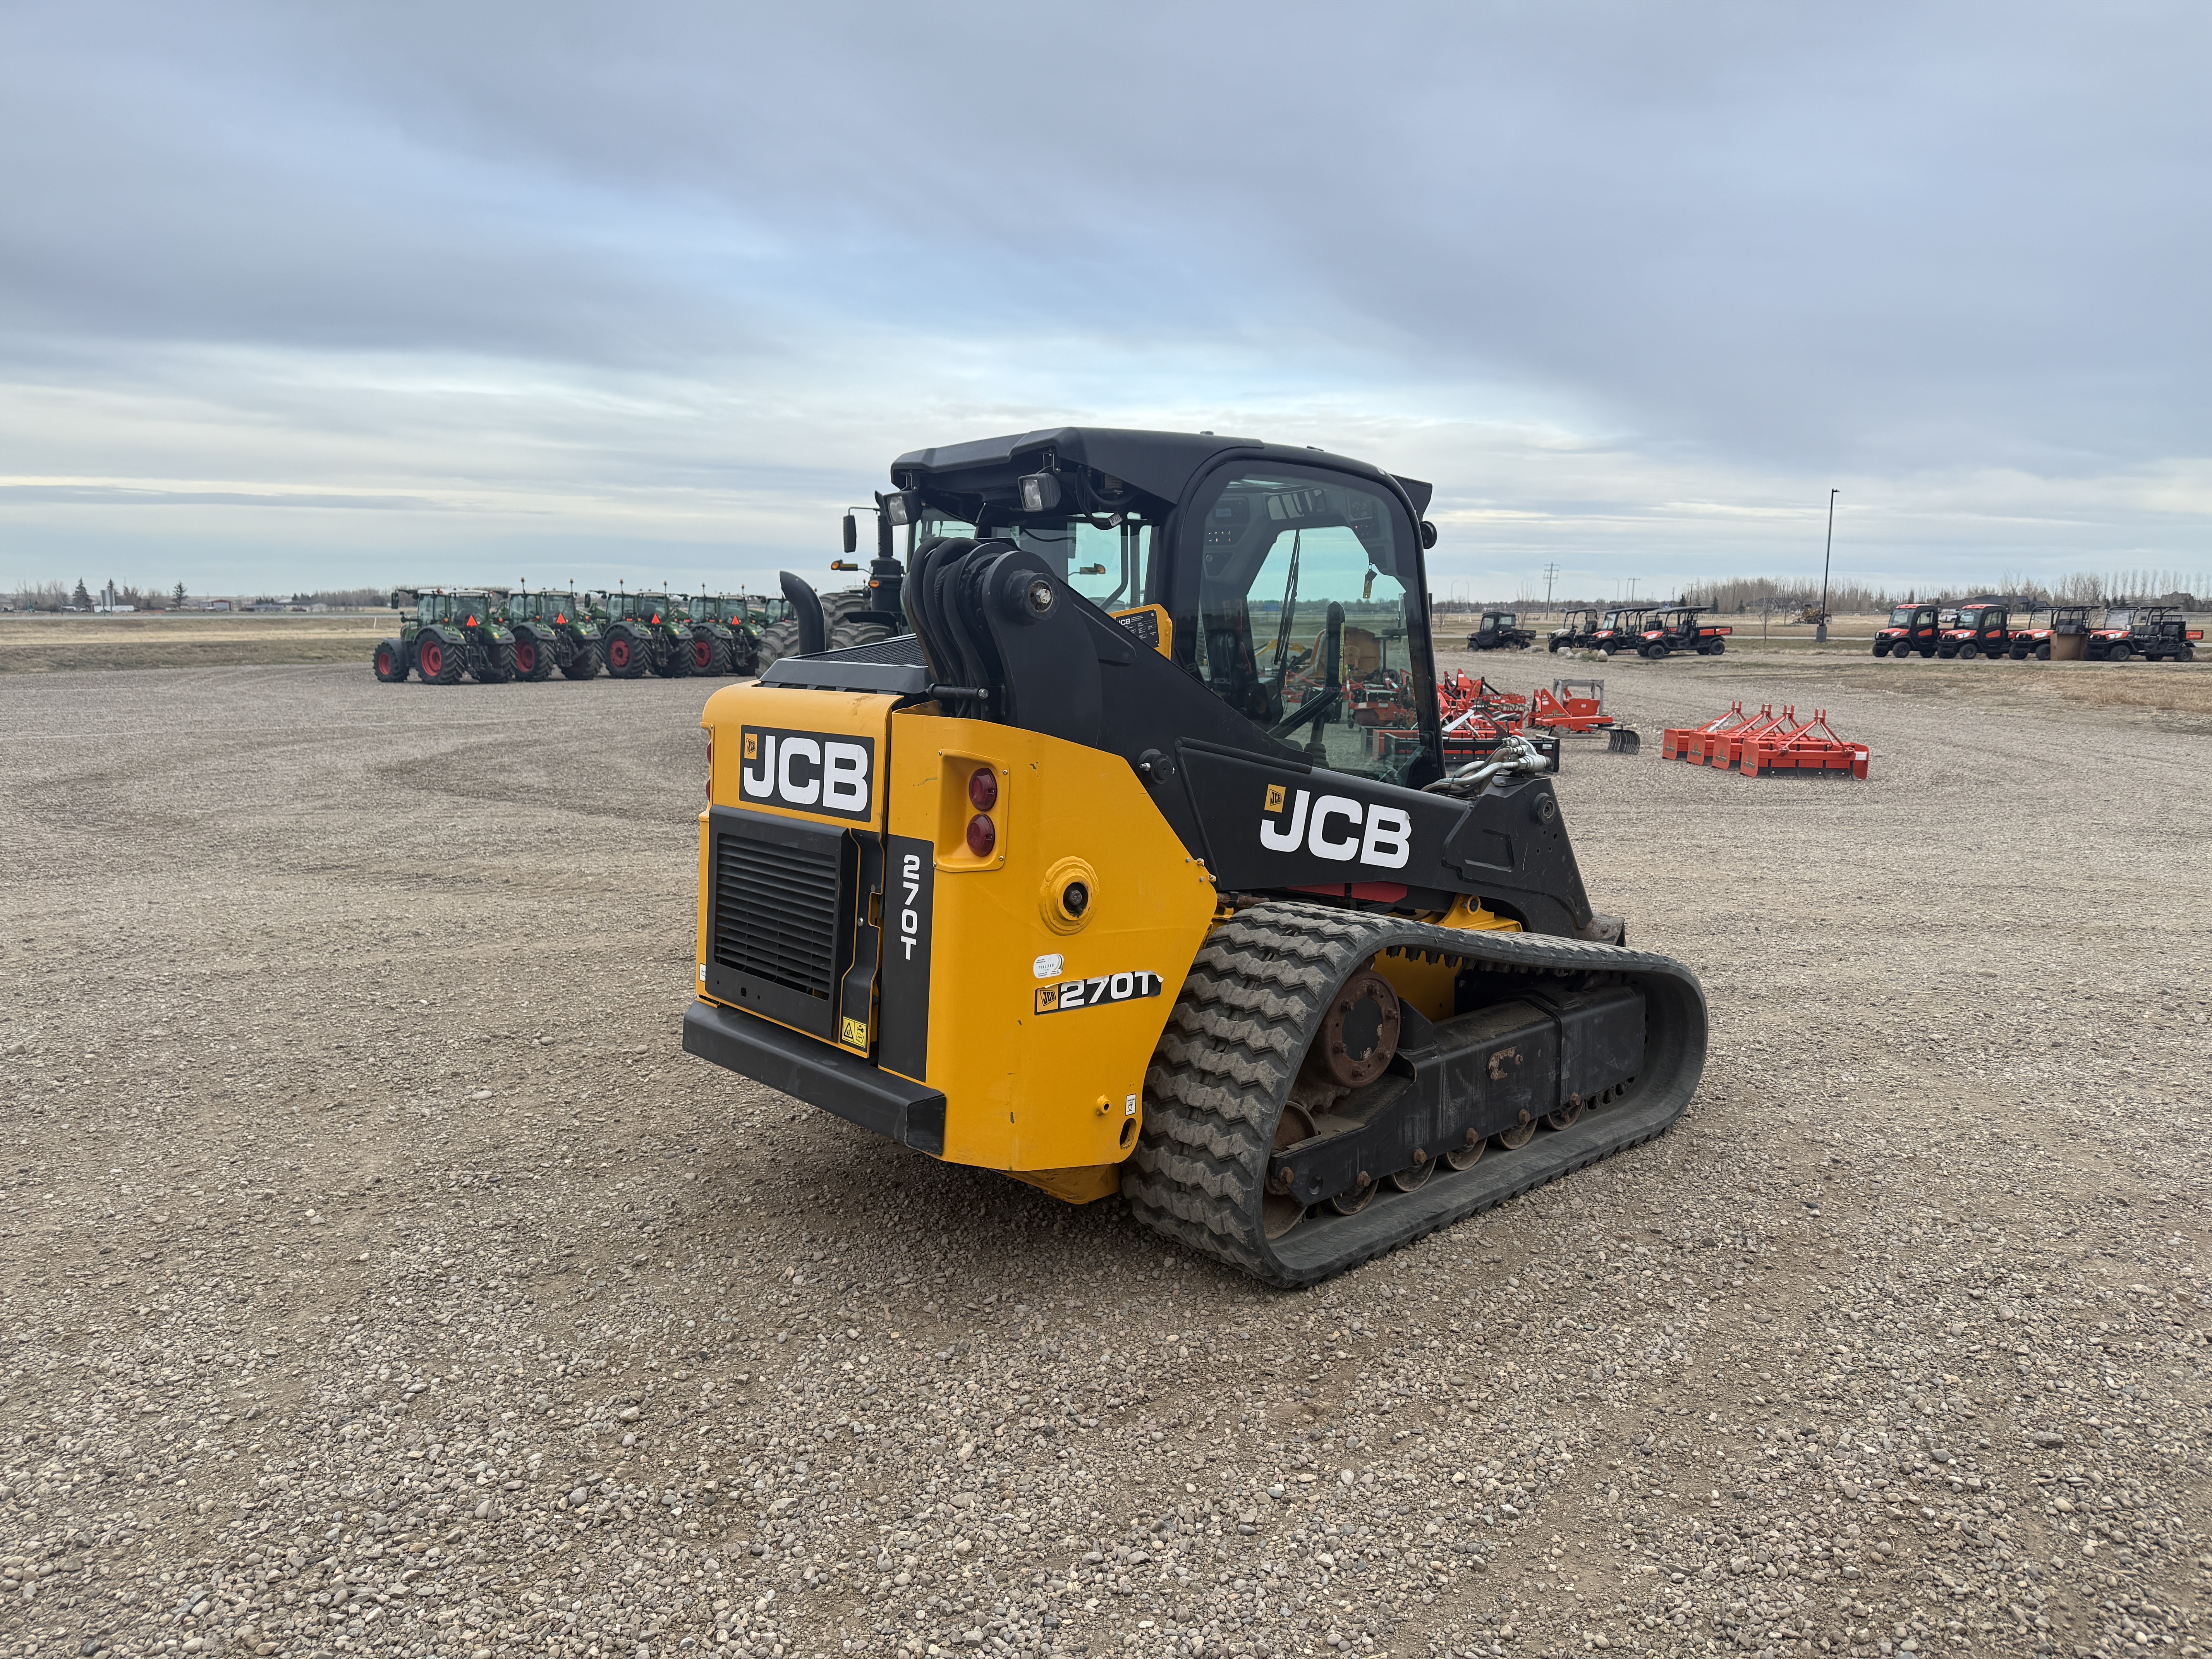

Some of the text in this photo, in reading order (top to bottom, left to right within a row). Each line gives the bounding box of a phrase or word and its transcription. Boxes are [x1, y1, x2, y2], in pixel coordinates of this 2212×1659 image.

[744, 735, 868, 812] JCB
[1271, 791, 1281, 804] JCB
[1260, 789, 1412, 869] JCB
[901, 854, 920, 960] 270T
[1042, 991, 1055, 1004] JCB
[1060, 970, 1156, 1009] 270T
